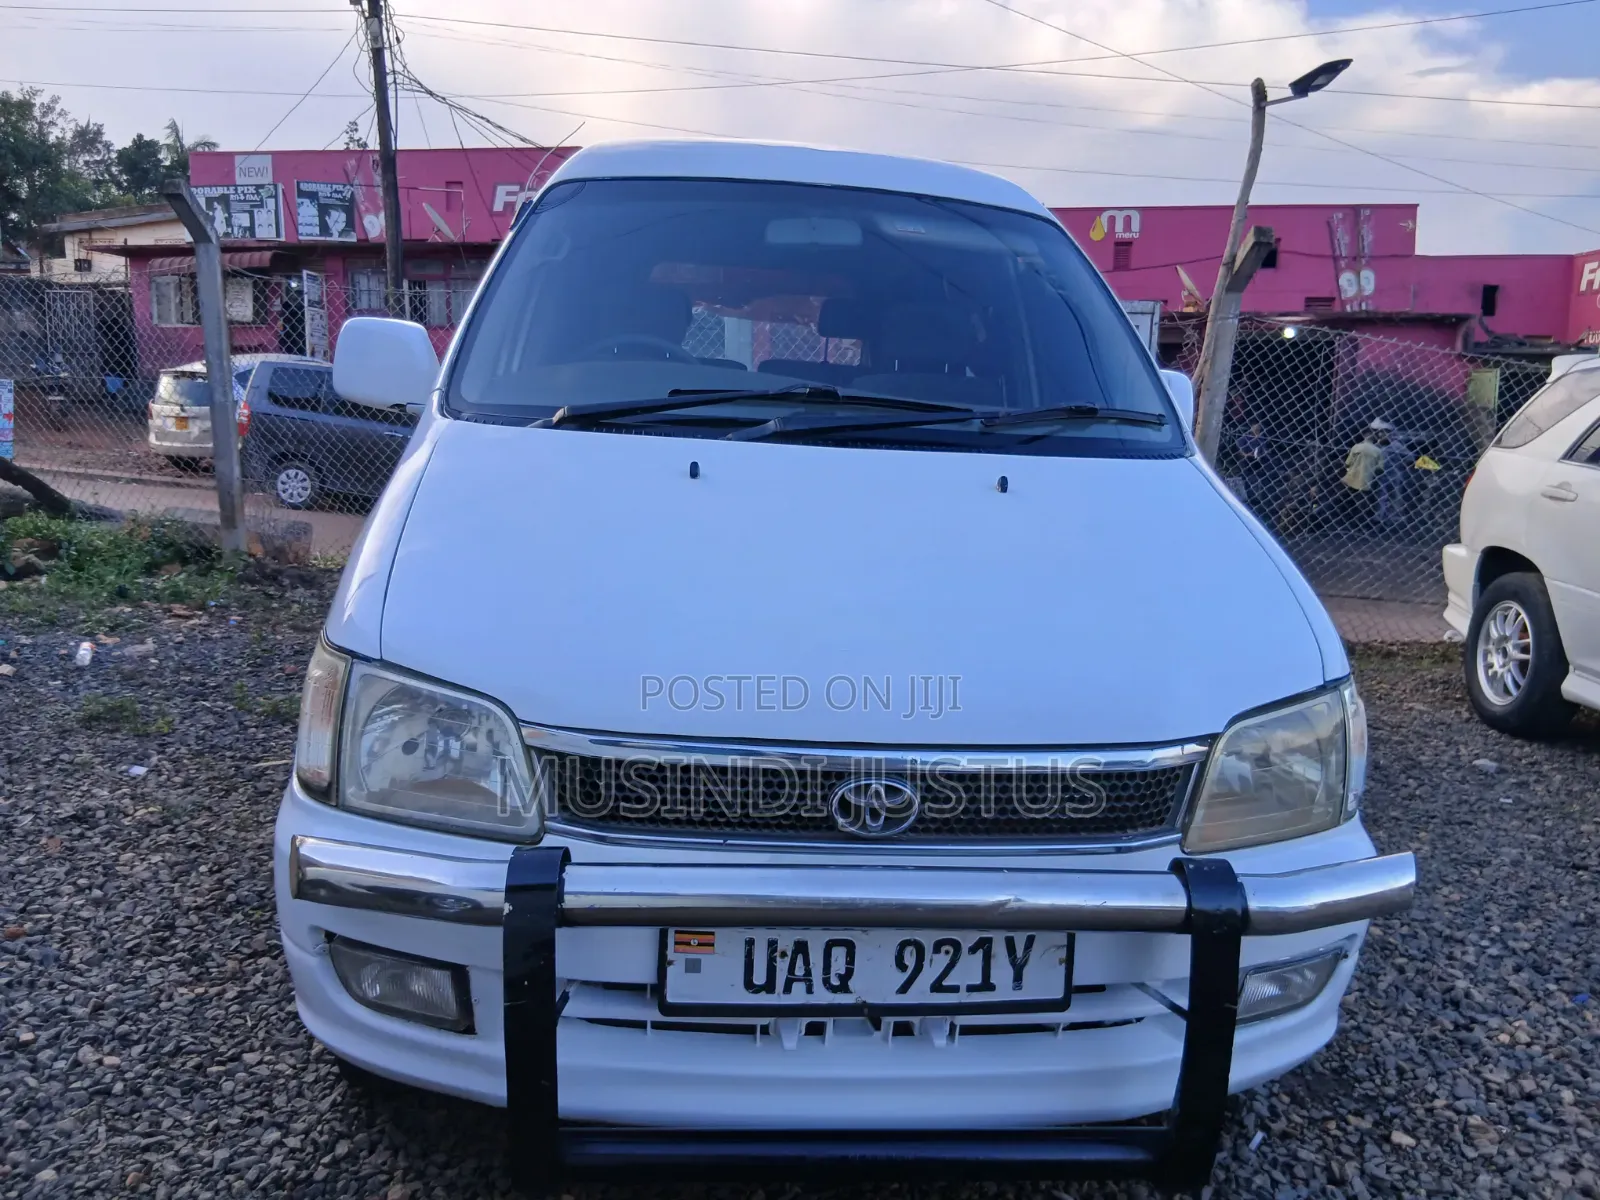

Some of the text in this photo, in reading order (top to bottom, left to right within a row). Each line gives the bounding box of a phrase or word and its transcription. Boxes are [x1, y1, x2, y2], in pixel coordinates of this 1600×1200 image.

[238, 166, 269, 178] NEW!
[190, 186, 257, 195] DORABLE PIX
[742, 933, 1037, 995] UAQ 921Y
